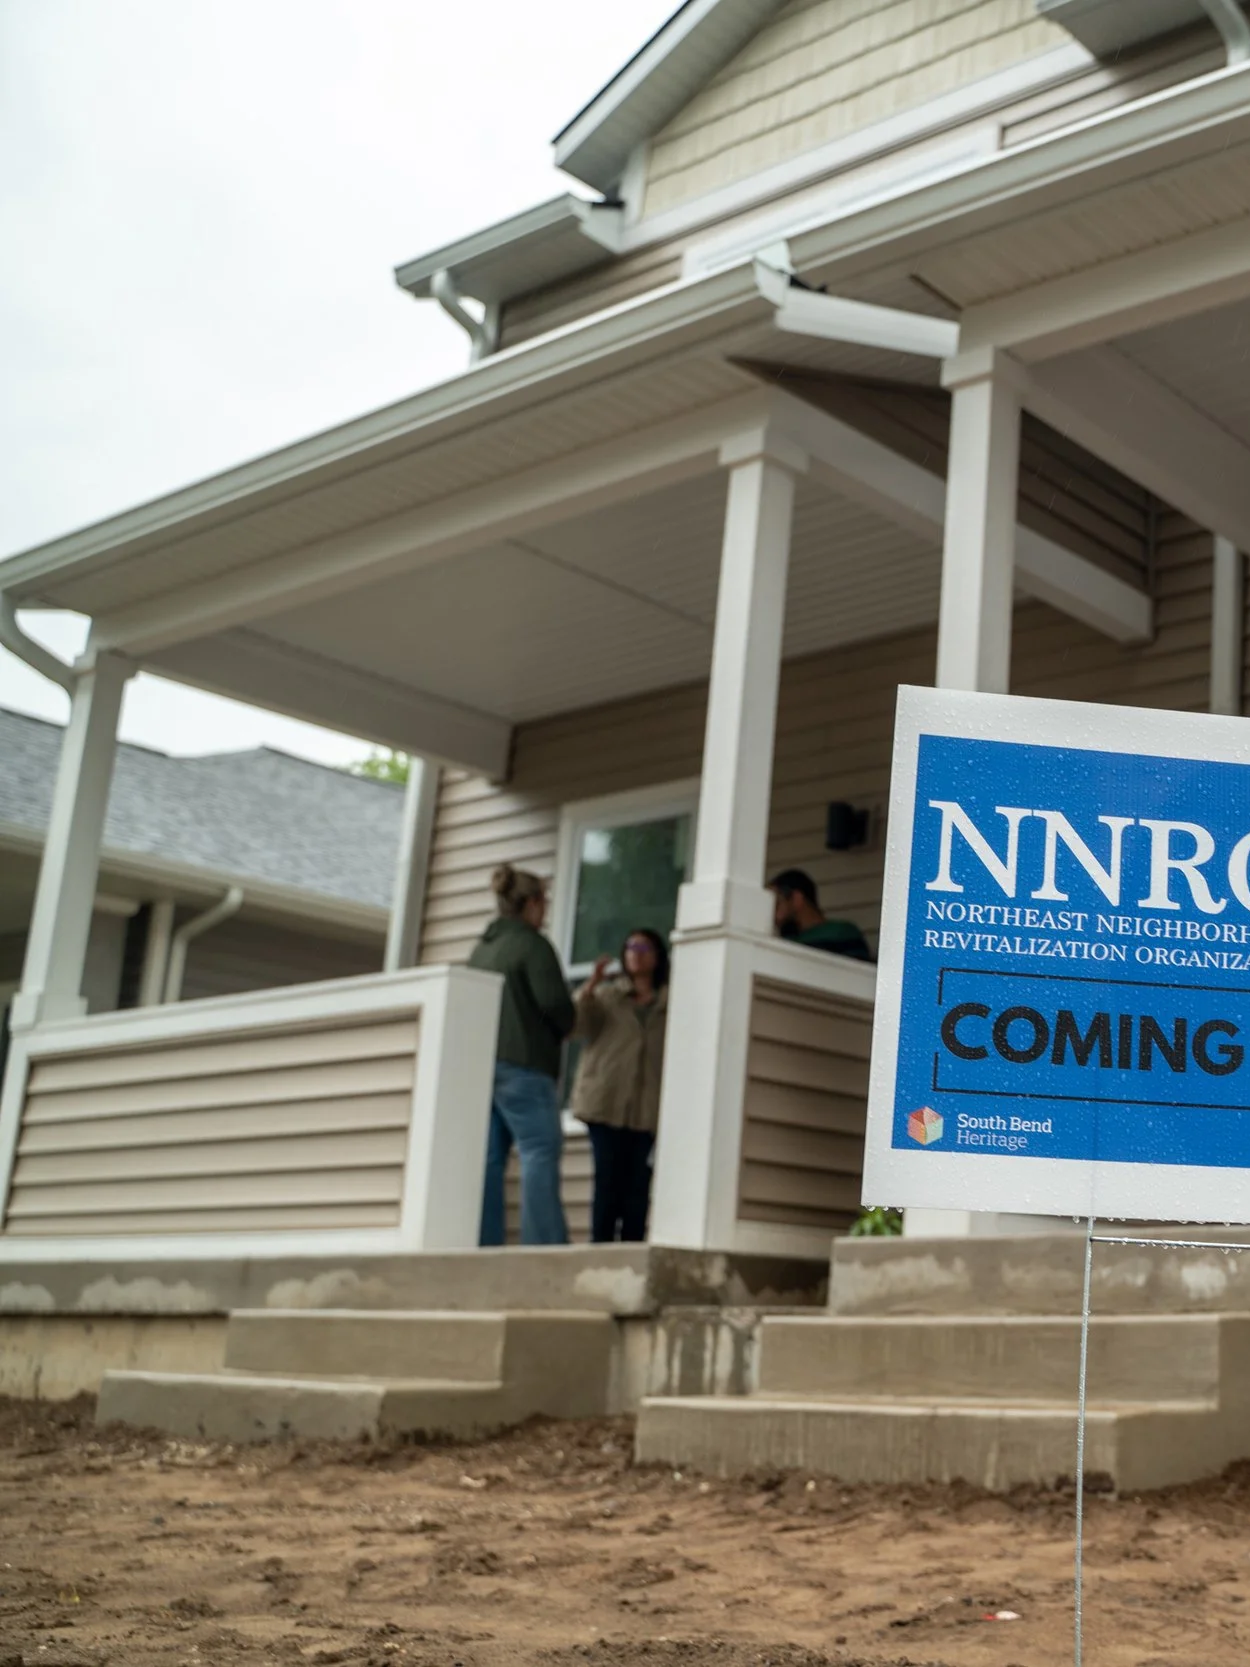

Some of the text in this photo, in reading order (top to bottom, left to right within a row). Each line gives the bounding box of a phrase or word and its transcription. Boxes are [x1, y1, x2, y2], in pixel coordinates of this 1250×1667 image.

[926, 900, 1089, 932] NORTHEAST
[923, 929, 1128, 961] REVITALIZATION
[939, 1002, 1245, 1077] COMING
[957, 1113, 1053, 1133] South Bend
[956, 1130, 1028, 1150] Heritage
